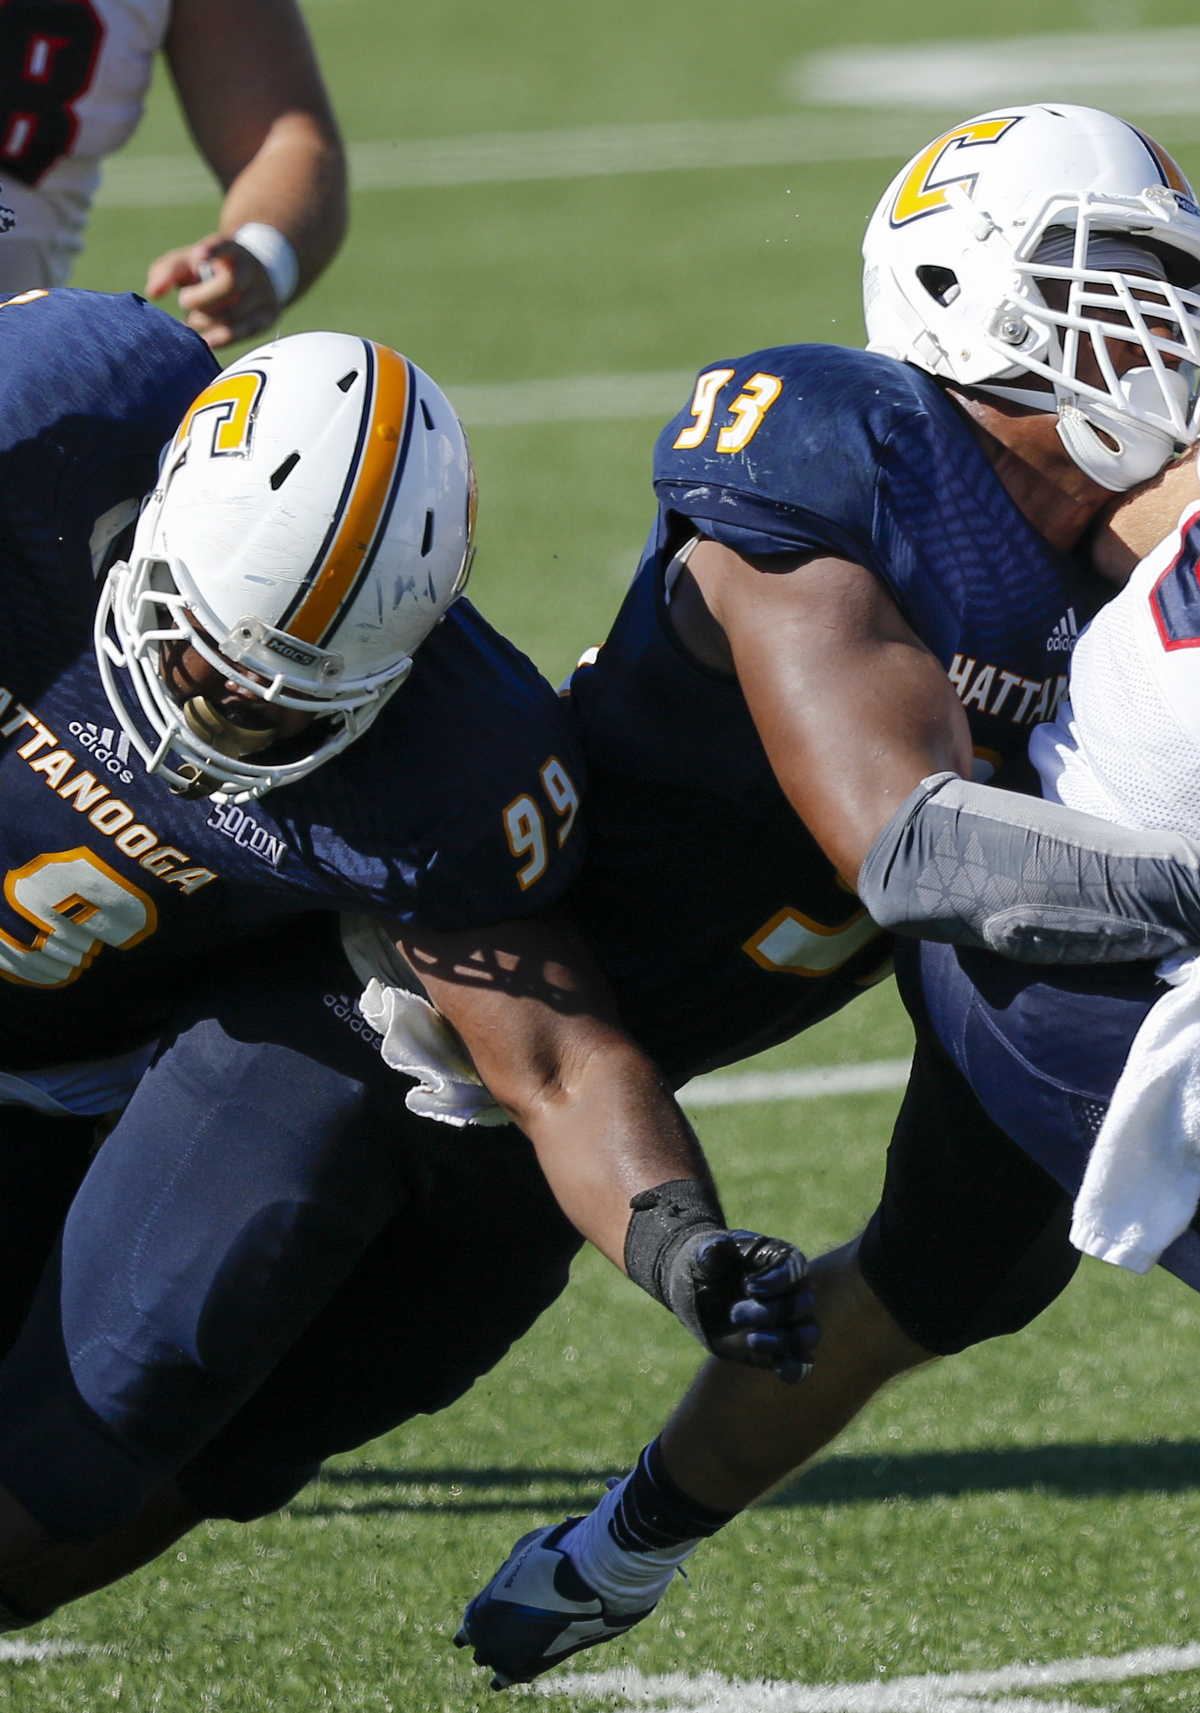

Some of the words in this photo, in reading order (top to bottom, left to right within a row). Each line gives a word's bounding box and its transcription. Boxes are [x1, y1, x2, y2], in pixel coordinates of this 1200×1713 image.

[890, 116, 1026, 230] C
[672, 368, 784, 454] 93
[268, 640, 316, 666] MOCS
[68, 720, 134, 785] adidas
[502, 755, 581, 891] 99
[323, 994, 382, 1050] adidas
